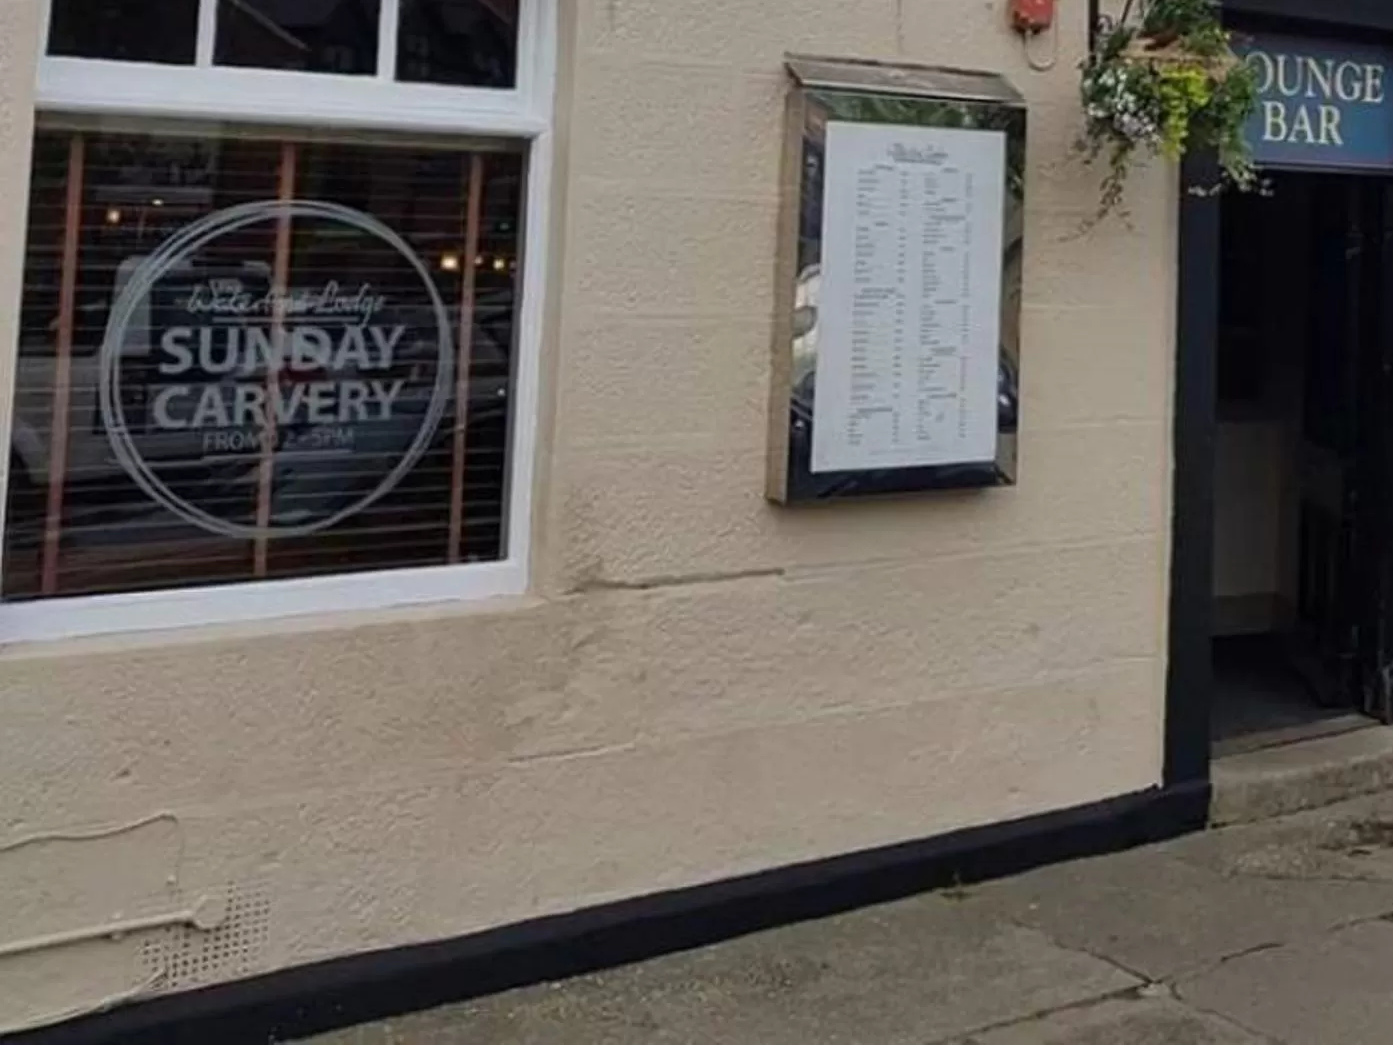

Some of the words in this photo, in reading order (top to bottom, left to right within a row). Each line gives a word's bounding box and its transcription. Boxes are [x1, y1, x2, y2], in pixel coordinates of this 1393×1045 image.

[1246, 51, 1384, 103] OUNGE
[1262, 100, 1343, 146] BAR
[159, 324, 405, 375] SUNDAY
[151, 378, 405, 430] CARVERY
